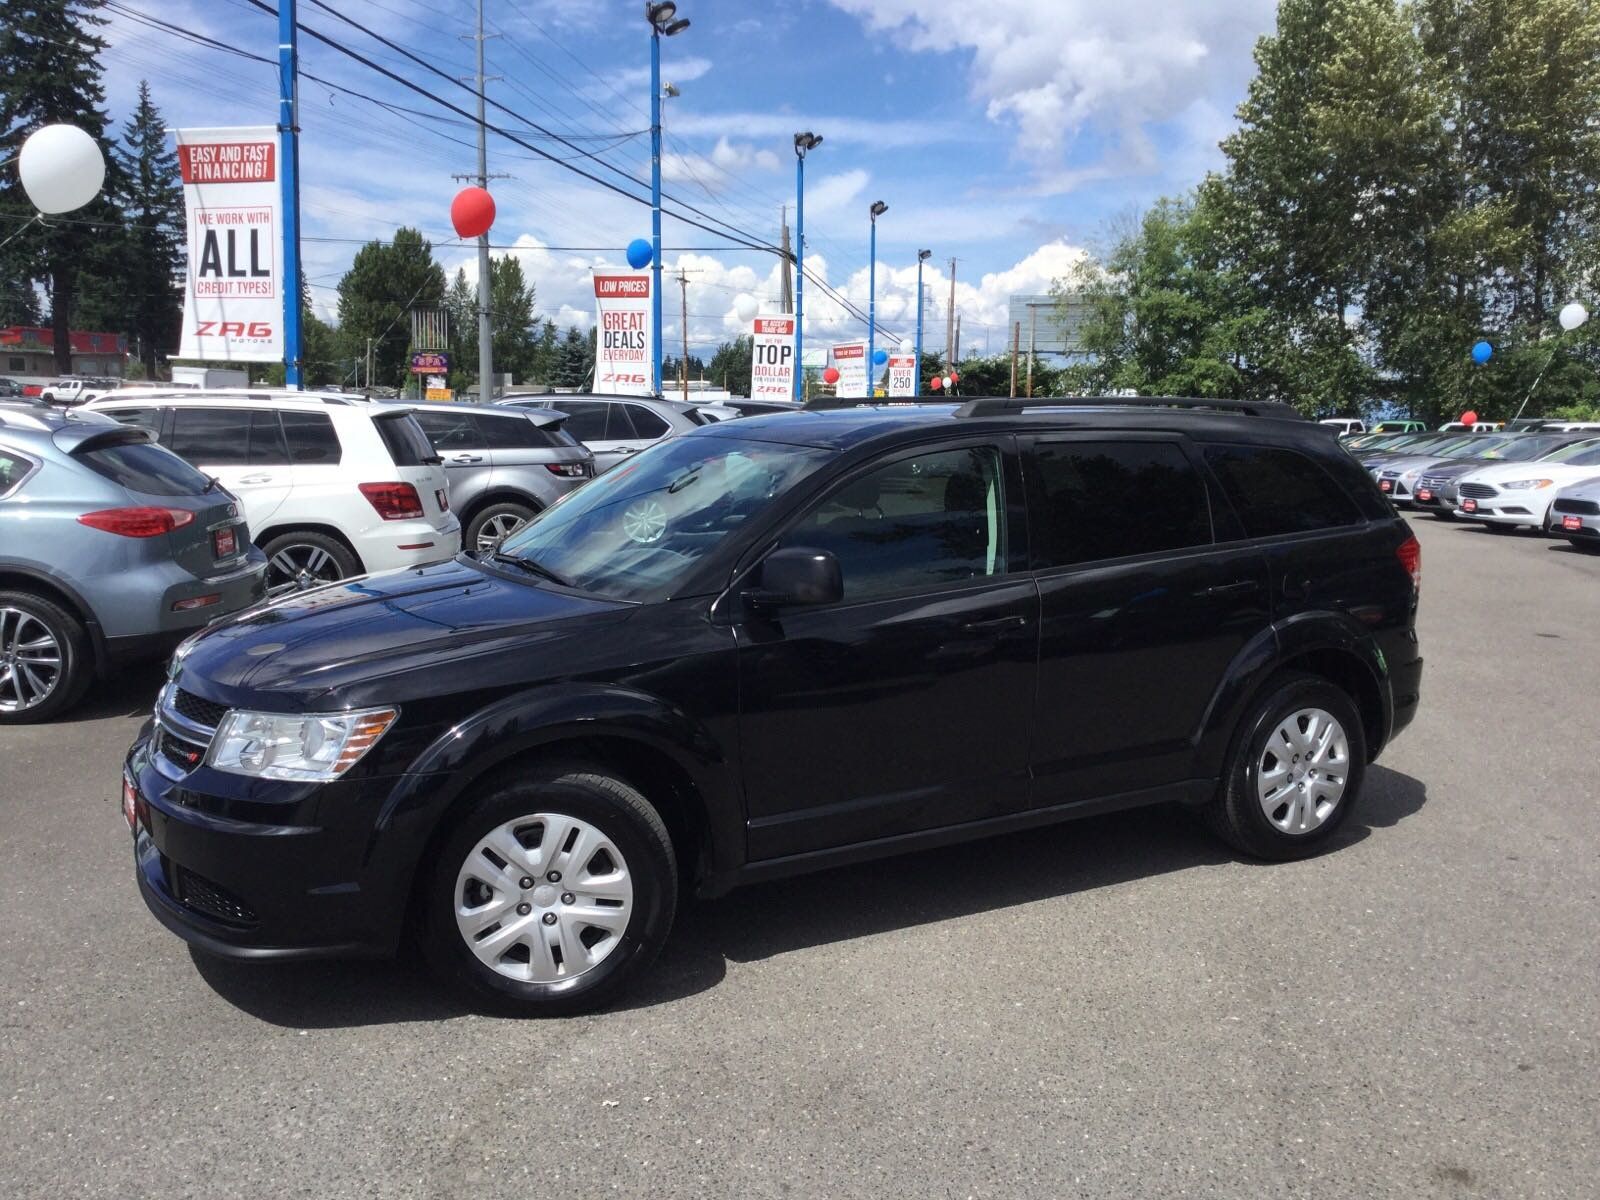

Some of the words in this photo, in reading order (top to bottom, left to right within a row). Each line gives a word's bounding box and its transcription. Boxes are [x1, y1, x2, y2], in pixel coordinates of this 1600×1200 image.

[190, 146, 217, 163] EASY
[220, 146, 241, 162] AND
[244, 144, 270, 161] FAST
[190, 161, 268, 180] FINANCING!
[198, 214, 212, 225] WE
[215, 212, 244, 225] WORK
[247, 212, 270, 224] WITH
[199, 228, 270, 278] ALL
[197, 282, 234, 294] CREDIT
[236, 282, 272, 294] TYPES!
[600, 281, 617, 292] LOW
[618, 280, 646, 293] PRICES
[603, 312, 644, 330] GREAT
[193, 321, 272, 338] ZAG
[604, 331, 644, 349] DEALS
[604, 350, 644, 361] EVERYDAY
[756, 344, 792, 365] TOP
[602, 374, 646, 383] ZAG
[754, 366, 790, 376] DOLLAR
[894, 377, 910, 388] 250
